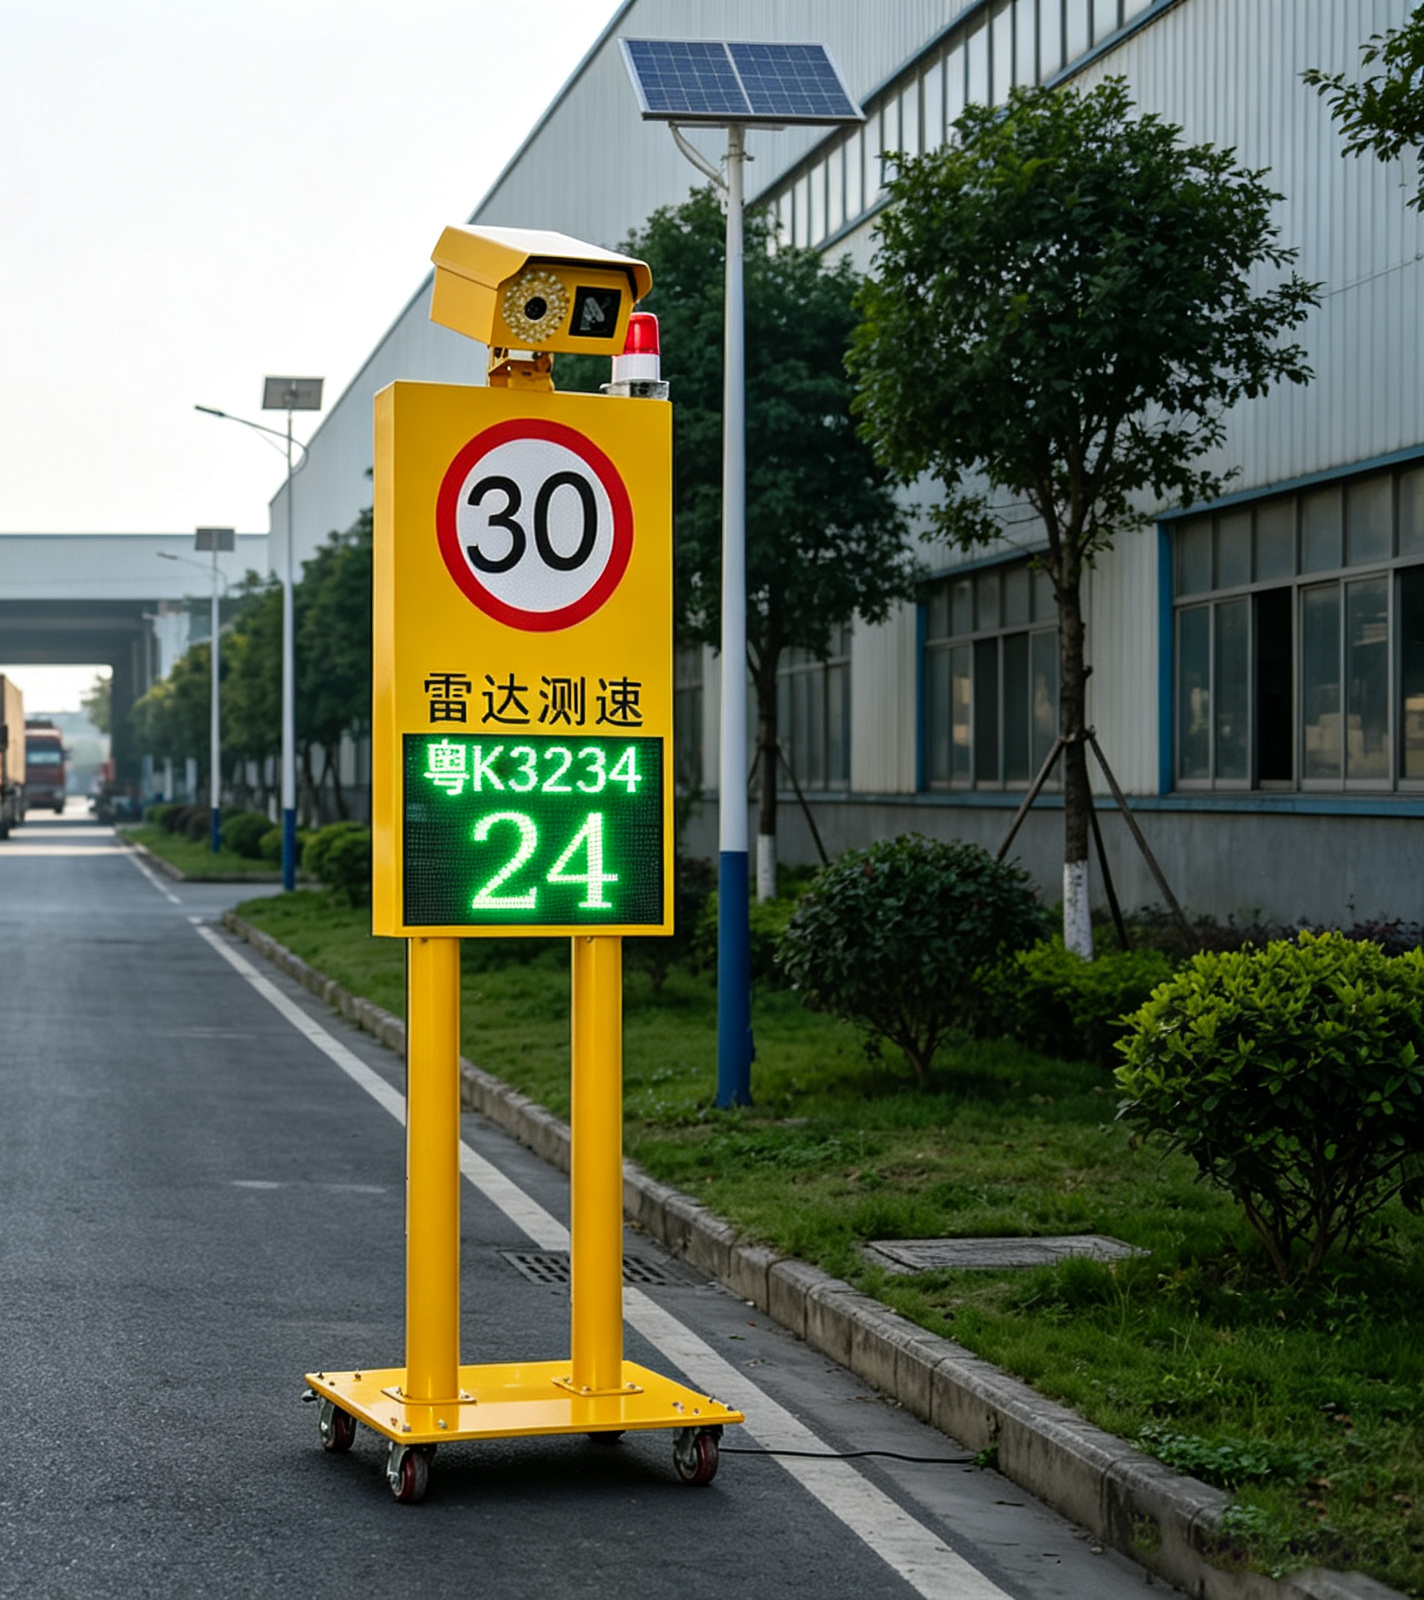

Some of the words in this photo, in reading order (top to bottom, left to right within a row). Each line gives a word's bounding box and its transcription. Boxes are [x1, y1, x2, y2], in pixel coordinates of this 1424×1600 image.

[466, 471, 598, 573] 30
[423, 672, 645, 728] 雷达测速
[423, 738, 643, 796] 粤K3234
[471, 811, 619, 911] 24
